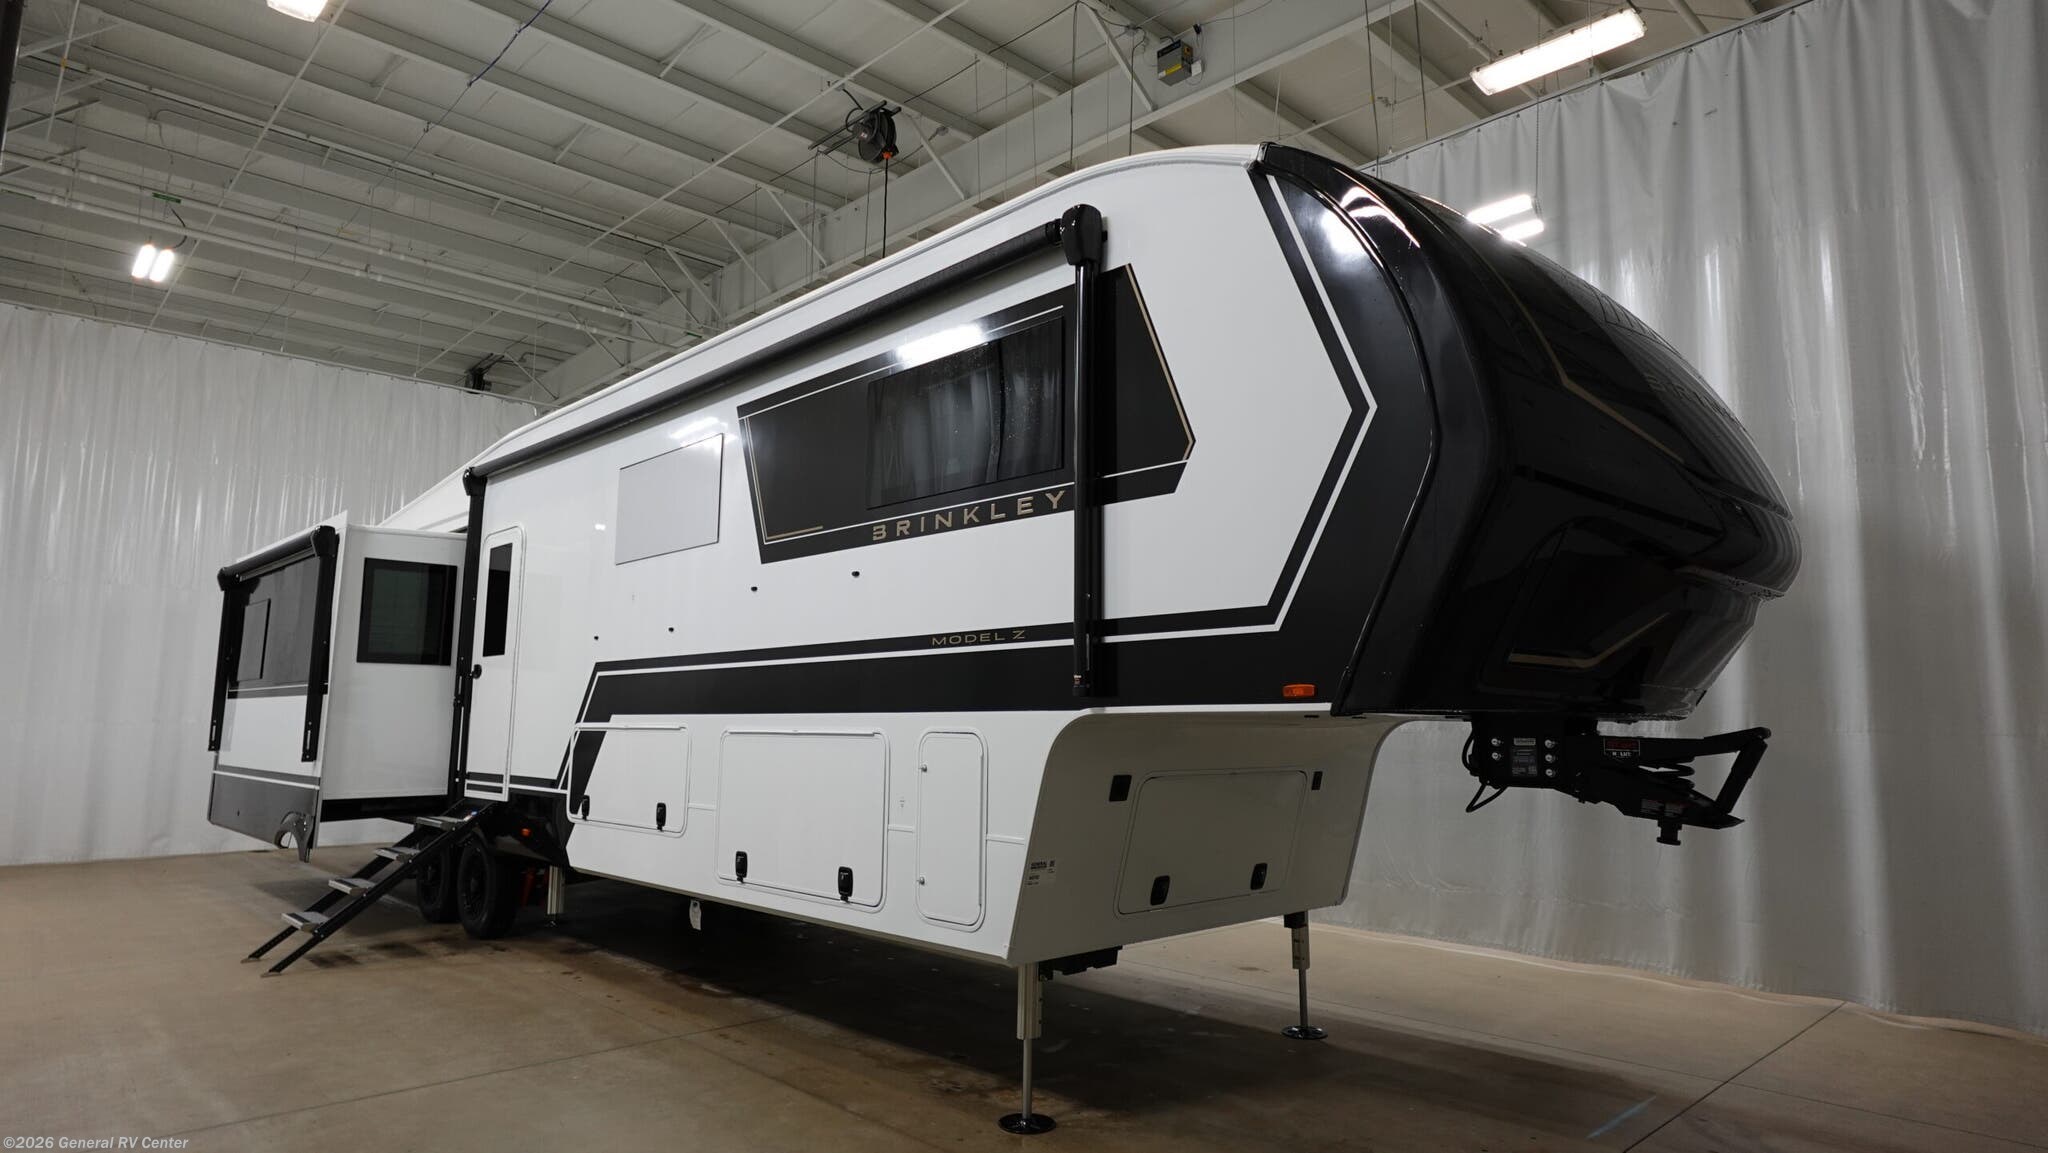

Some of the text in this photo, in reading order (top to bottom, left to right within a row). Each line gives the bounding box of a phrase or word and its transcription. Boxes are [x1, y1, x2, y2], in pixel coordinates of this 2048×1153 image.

[872, 490, 1066, 541] BRINKLEY
[932, 630, 1025, 646] MODEL Z
